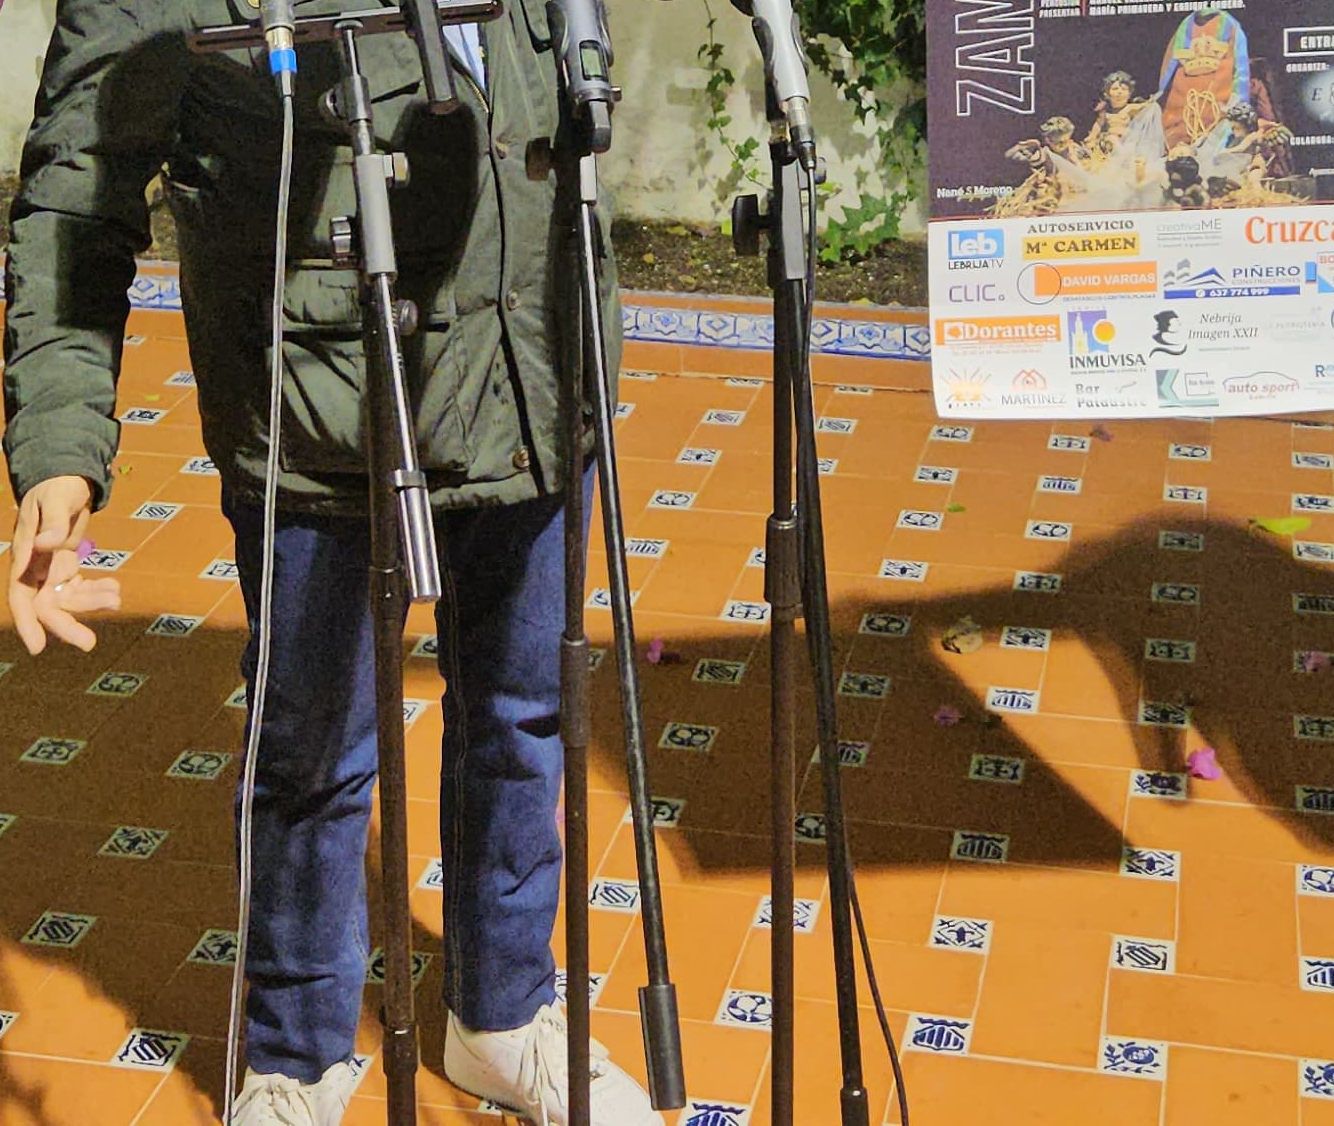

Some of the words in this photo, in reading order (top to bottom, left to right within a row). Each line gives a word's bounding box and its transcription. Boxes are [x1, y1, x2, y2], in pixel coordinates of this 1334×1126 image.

[1027, 220, 1135, 234] AUTOSERVICIO
[1054, 237, 1137, 253] CARMEN
[1232, 264, 1301, 278] PIÑERO
[1063, 275, 1100, 287] DAVID
[1104, 272, 1156, 285] VARGAS
[1209, 288, 1230, 297] 637
[1231, 288, 1249, 296] 774
[1199, 312, 1243, 326] Nebrija
[964, 322, 1057, 340] Dorantes
[1188, 329, 1230, 341] Imagen
[1070, 353, 1147, 370] INMUVISA
[1227, 384, 1258, 394] auto
[1262, 381, 1297, 396] sport
